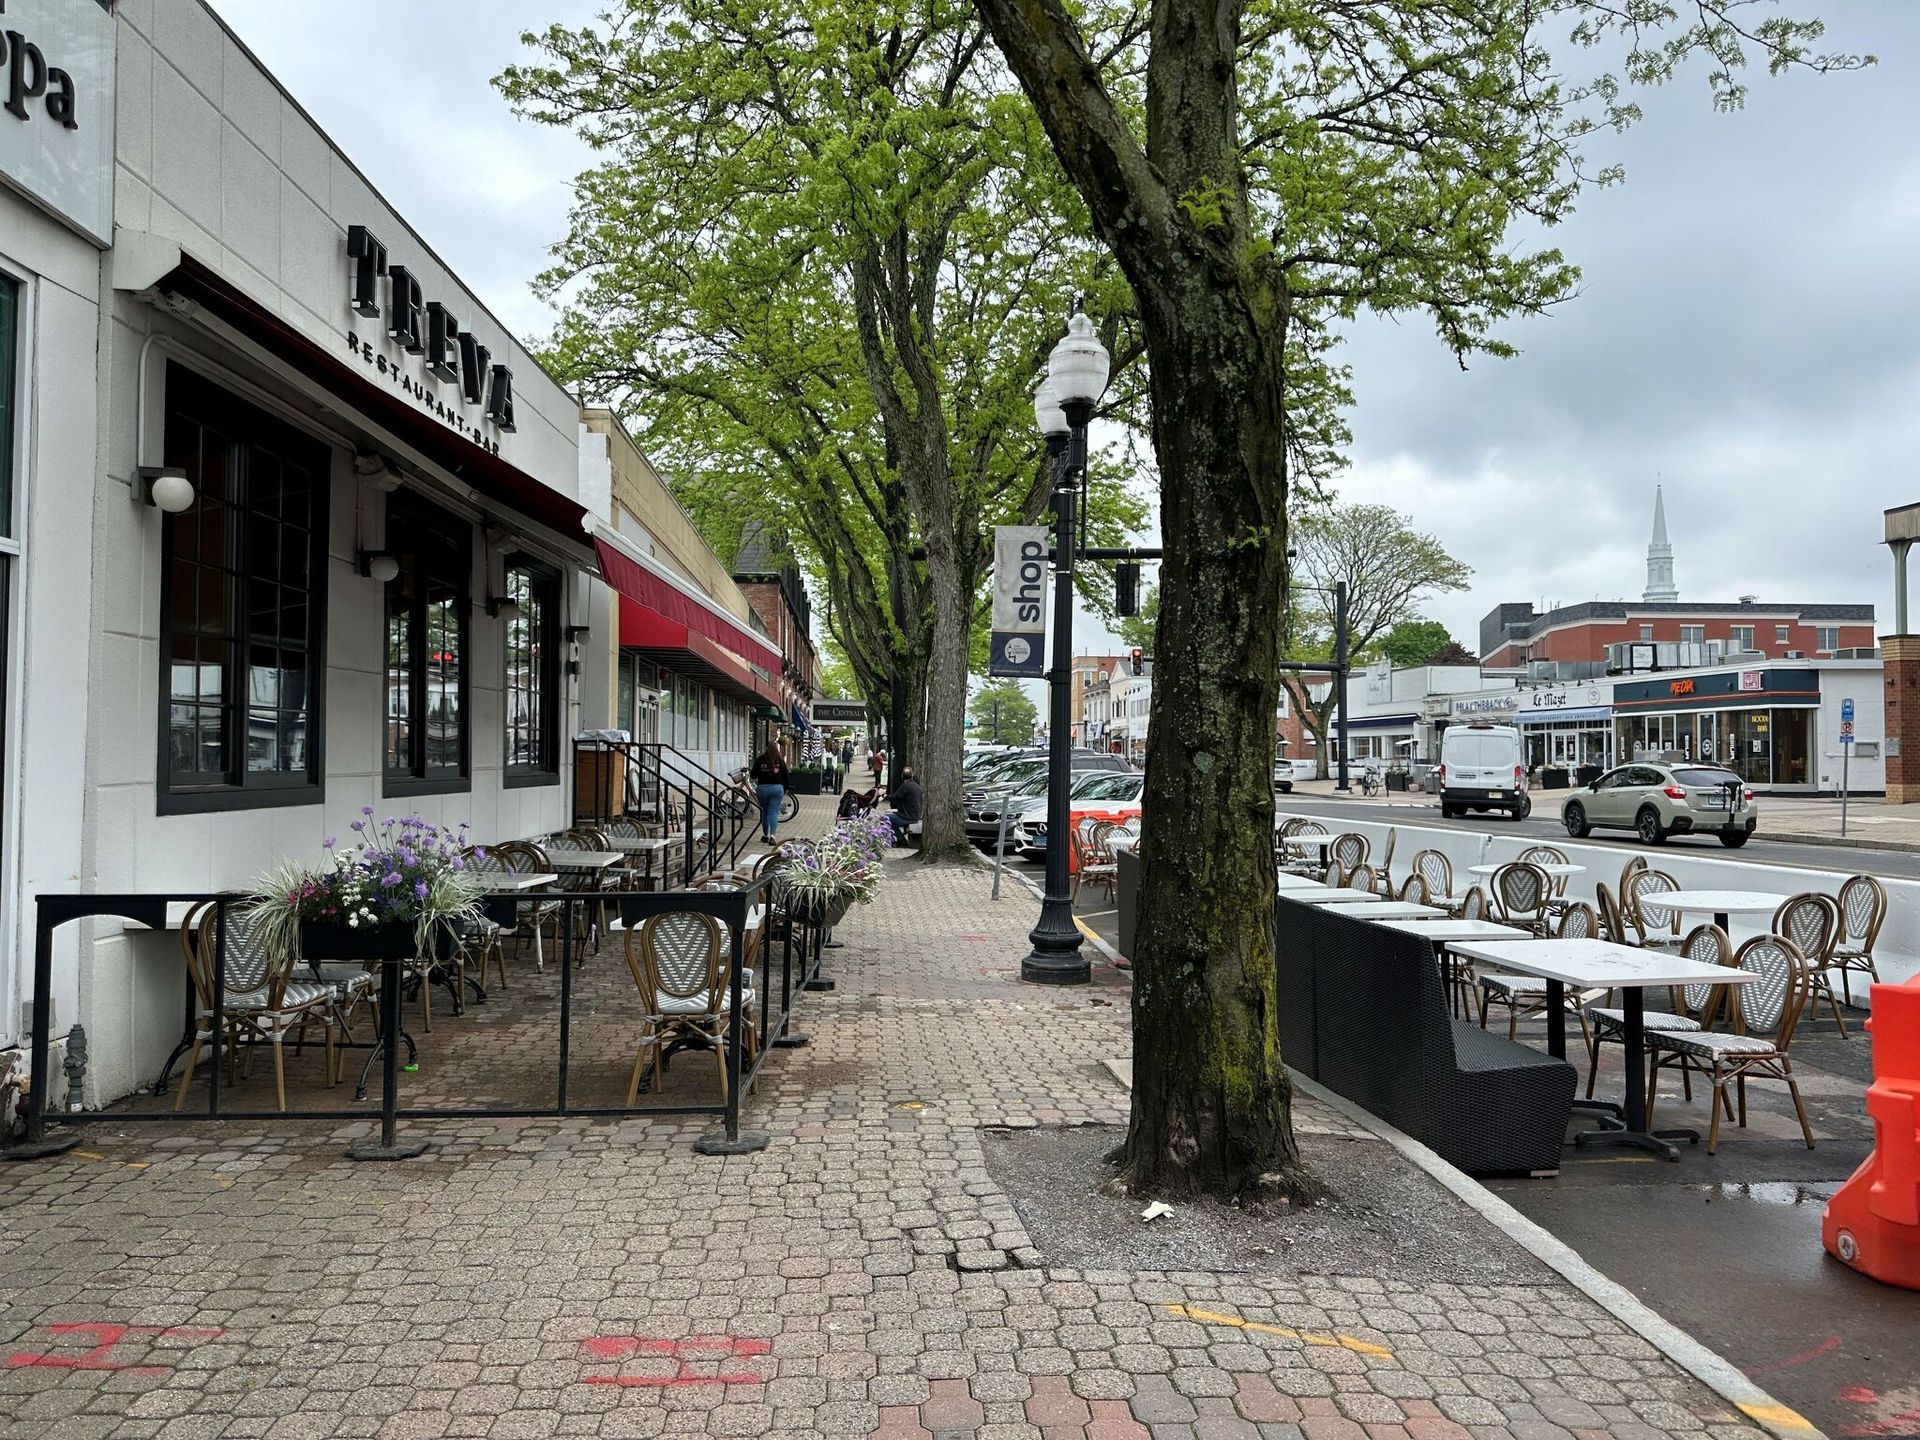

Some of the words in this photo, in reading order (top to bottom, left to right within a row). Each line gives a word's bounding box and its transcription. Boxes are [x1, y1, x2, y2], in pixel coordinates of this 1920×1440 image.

[347, 225, 517, 433] TREVA
[348, 330, 465, 432] RESTAURANT
[474, 428, 500, 456] BAR
[1012, 541, 1050, 623] shop
[1533, 693, 1541, 707] Le
[1544, 691, 1567, 708] Mazet
